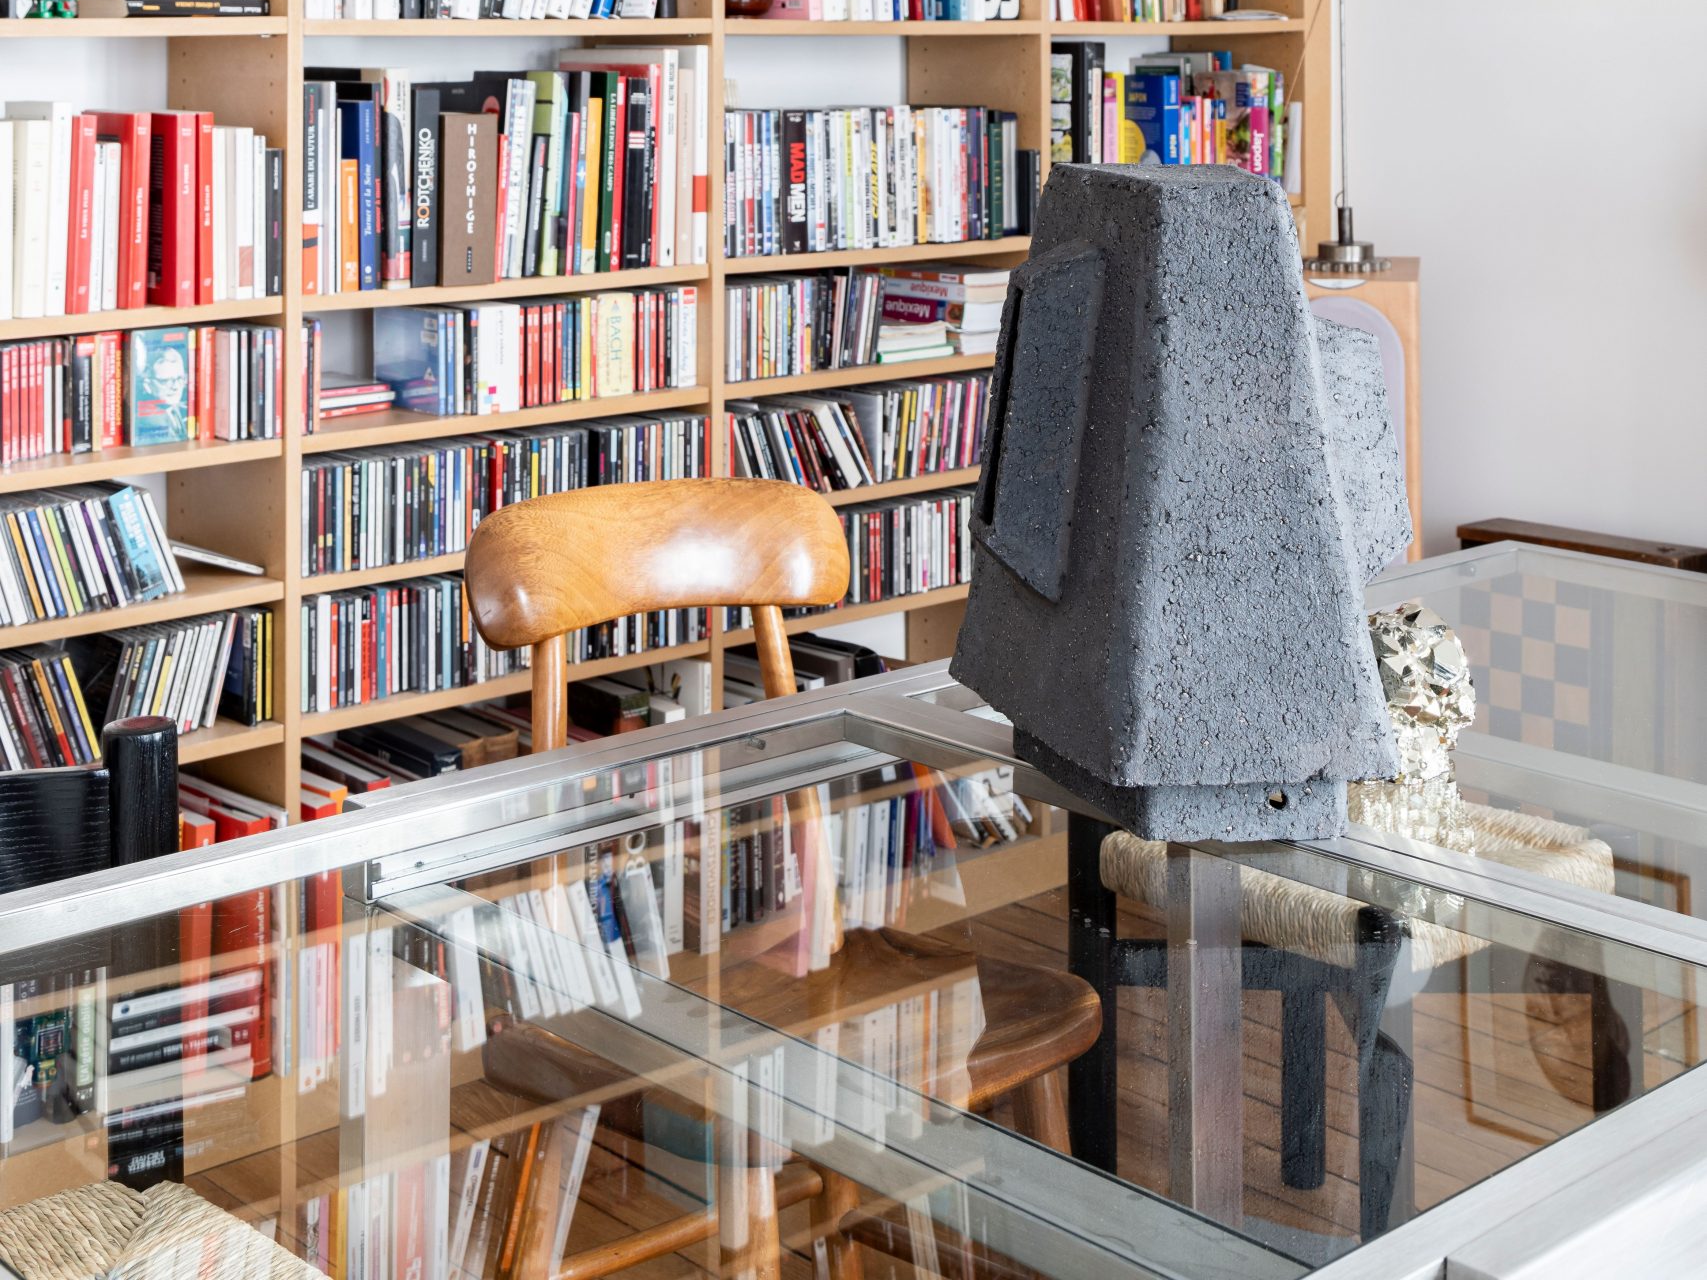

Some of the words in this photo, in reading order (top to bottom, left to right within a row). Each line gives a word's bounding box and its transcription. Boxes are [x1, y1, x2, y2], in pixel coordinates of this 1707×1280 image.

[307, 125, 315, 157] FUTUR
[1252, 129, 1264, 172] Japon
[307, 158, 315, 170] DU
[417, 127, 432, 228] RODTCHENKO
[465, 123, 478, 234] HIROSHIGE
[790, 143, 806, 183] MAD
[871, 142, 879, 219] CHARADE
[790, 183, 806, 223] MEN
[885, 299, 930, 319] Mexique
[911, 282, 948, 298] Mexique
[609, 316, 623, 360] BACH
